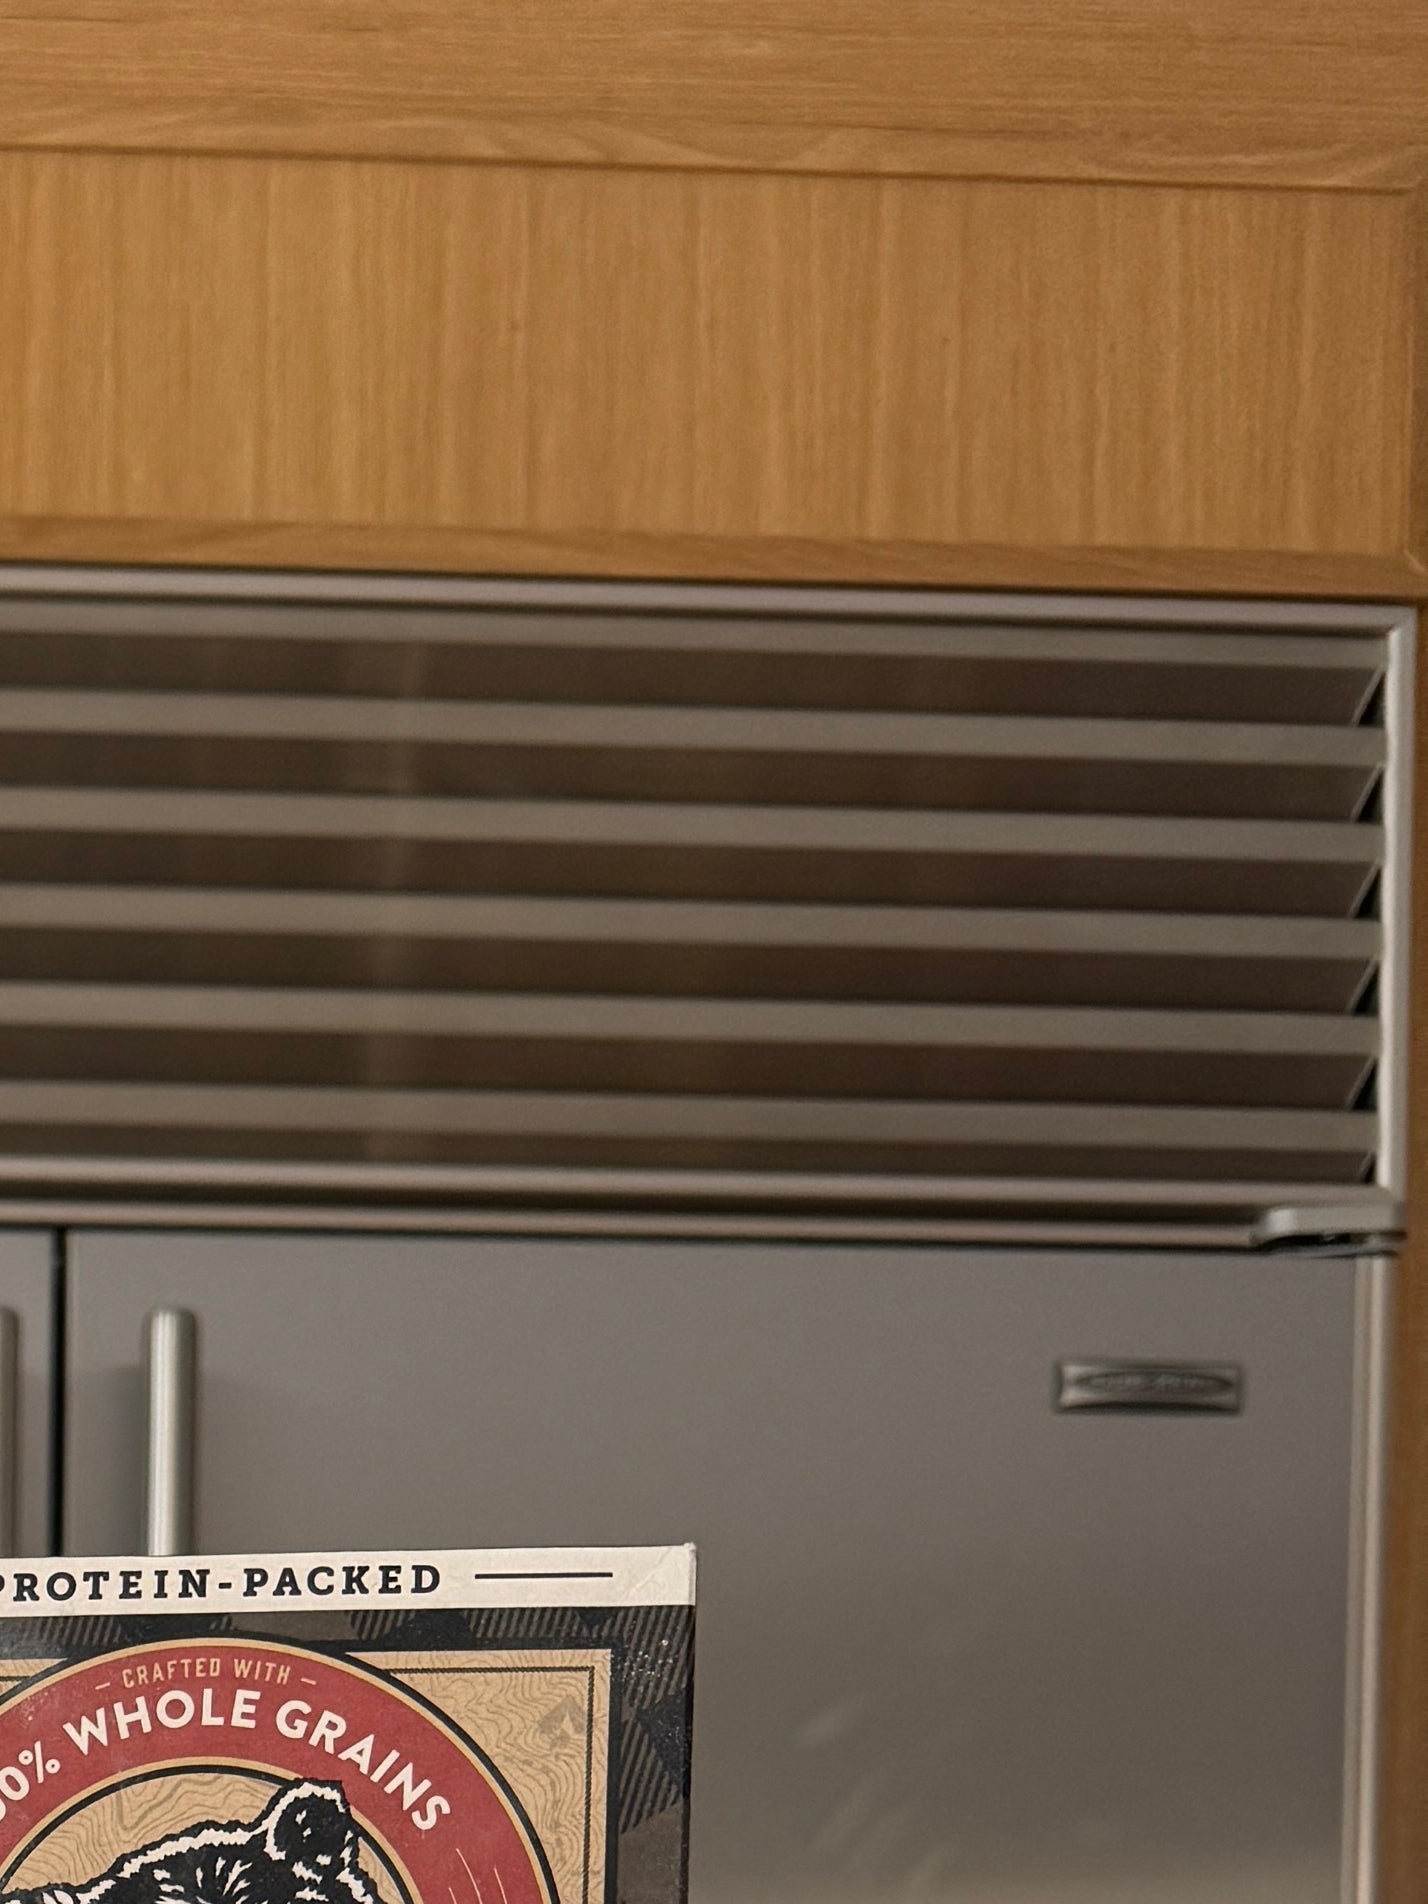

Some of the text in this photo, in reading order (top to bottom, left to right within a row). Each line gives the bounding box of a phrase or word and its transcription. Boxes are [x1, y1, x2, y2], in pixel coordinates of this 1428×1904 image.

[122, 1657, 292, 1690] CRAFTED WITH
[64, 1687, 259, 1759] WHOLE
[275, 1698, 452, 1836] GRAINS
